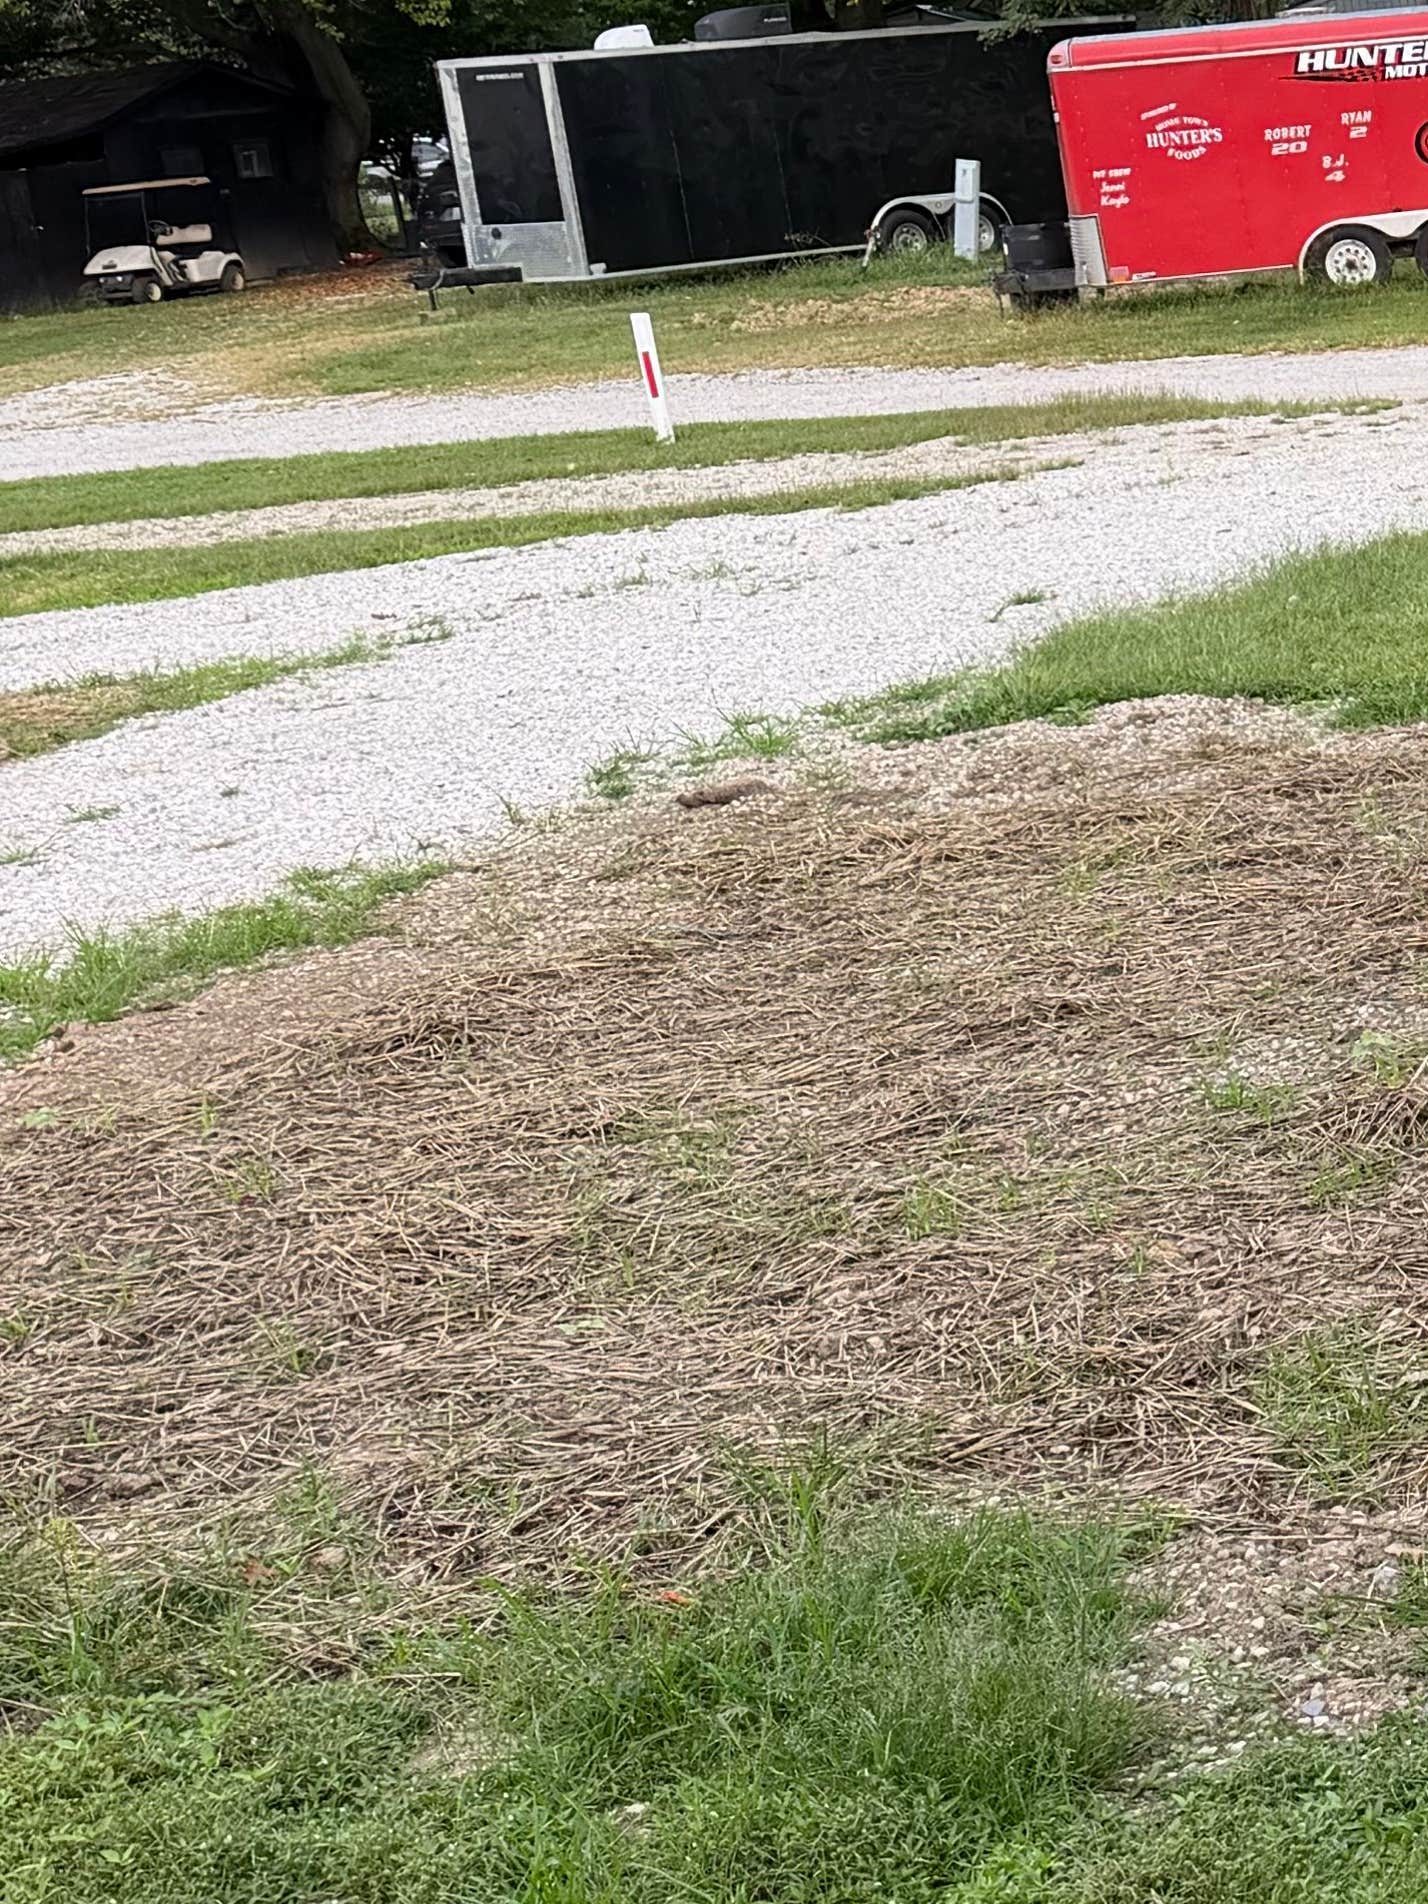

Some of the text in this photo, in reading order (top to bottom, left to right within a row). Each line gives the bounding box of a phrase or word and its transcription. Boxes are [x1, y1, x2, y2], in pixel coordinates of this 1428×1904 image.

[1341, 110, 1372, 125] RYAN
[1146, 127, 1223, 149] HUNTER'S
[1264, 124, 1312, 141] ROBERT
[1349, 126, 1368, 139] 2
[1271, 141, 1308, 156] 20
[1324, 169, 1346, 182] 4
